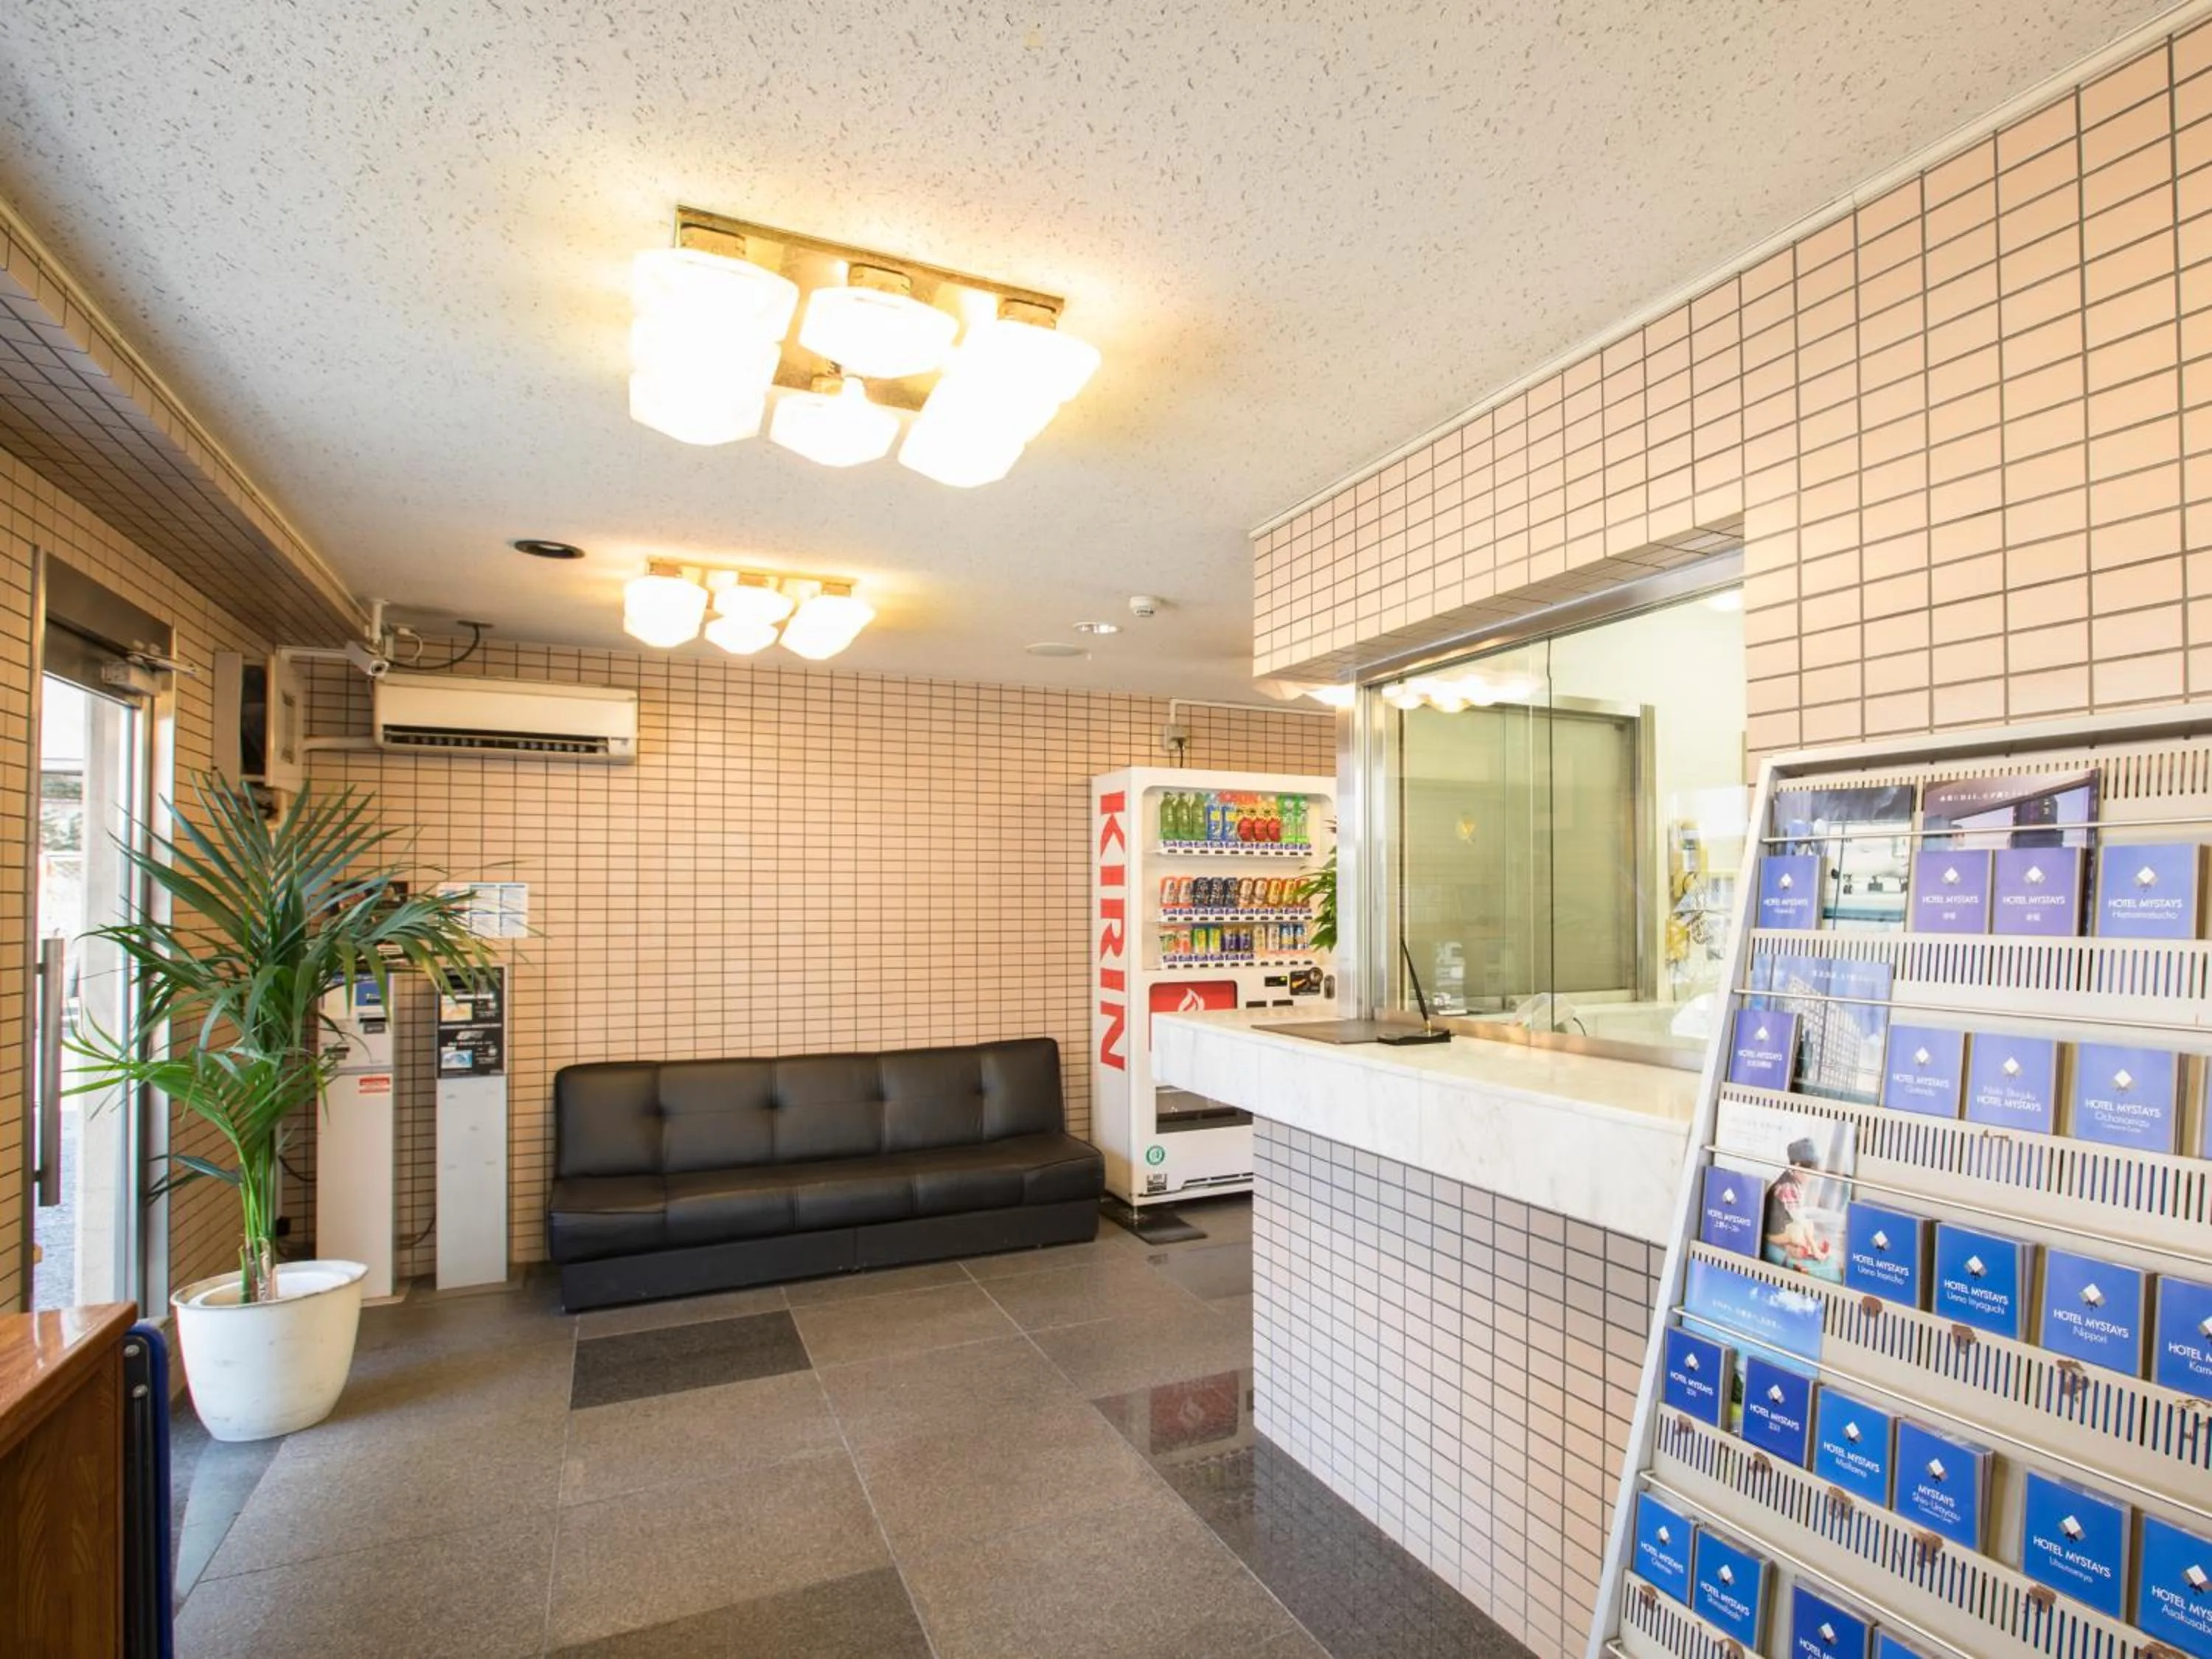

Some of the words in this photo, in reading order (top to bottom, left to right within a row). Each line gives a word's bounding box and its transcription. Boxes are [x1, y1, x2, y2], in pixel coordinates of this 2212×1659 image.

[1922, 895, 1944, 903] HOTEL
[1946, 895, 1979, 904] MYSTAYS
[2003, 896, 2028, 905] HOTEL
[2029, 895, 2065, 905] MYSTAYS
[2108, 897, 2136, 908] HOTEL
[2139, 898, 2183, 908] MYSTAYS
[1099, 790, 1125, 1072] KIRIN
[1893, 1073, 1914, 1084] HOTEL
[1916, 1077, 1950, 1088] MYSTAYS
[1977, 1095, 2002, 1107] HOTEL
[2004, 1099, 2042, 1112] MYSTAYS
[2085, 1098, 2114, 1111] HOTEL
[2117, 1104, 2162, 1119] MYSTAYS
[1707, 1208, 1724, 1220] HOTEL
[1724, 1212, 1751, 1227] MYSTAYS
[1852, 1253, 1874, 1267] HOTEL
[1875, 1260, 1910, 1277] MYSTAYS
[1944, 1279, 1969, 1294] HOTEL
[1971, 1286, 2008, 1306] MYSTAYS
[1947, 1292, 1966, 1304] Ueno
[2053, 1309, 2083, 1325] HOTEL
[2085, 1318, 2130, 1339] MYSTAYS
[2073, 1326, 2108, 1344] Nippori
[2168, 1341, 2202, 1360] HOTEL
[1670, 1371, 1687, 1385] HOTEL
[1688, 1378, 1714, 1396] MYSTAYS
[1750, 1403, 1769, 1419] HOTEL
[1770, 1412, 1801, 1432] MYSTAYS
[1823, 1441, 1846, 1458] HOTEL
[1847, 1451, 1880, 1473] MYSTAYS
[1918, 1484, 1955, 1509] MYSTAYS
[1641, 1540, 1658, 1557] HOTEL
[1658, 1551, 1684, 1573] MYSTAYS
[2033, 1536, 2064, 1557] HOTEL
[2065, 1550, 2112, 1579] MYSTAYS
[1700, 1580, 1720, 1600] HOTEL
[1720, 1593, 1750, 1617] MYSTAYS
[2152, 1584, 2186, 1610] HOTEL
[1799, 1636, 1821, 1659] HOTEL
